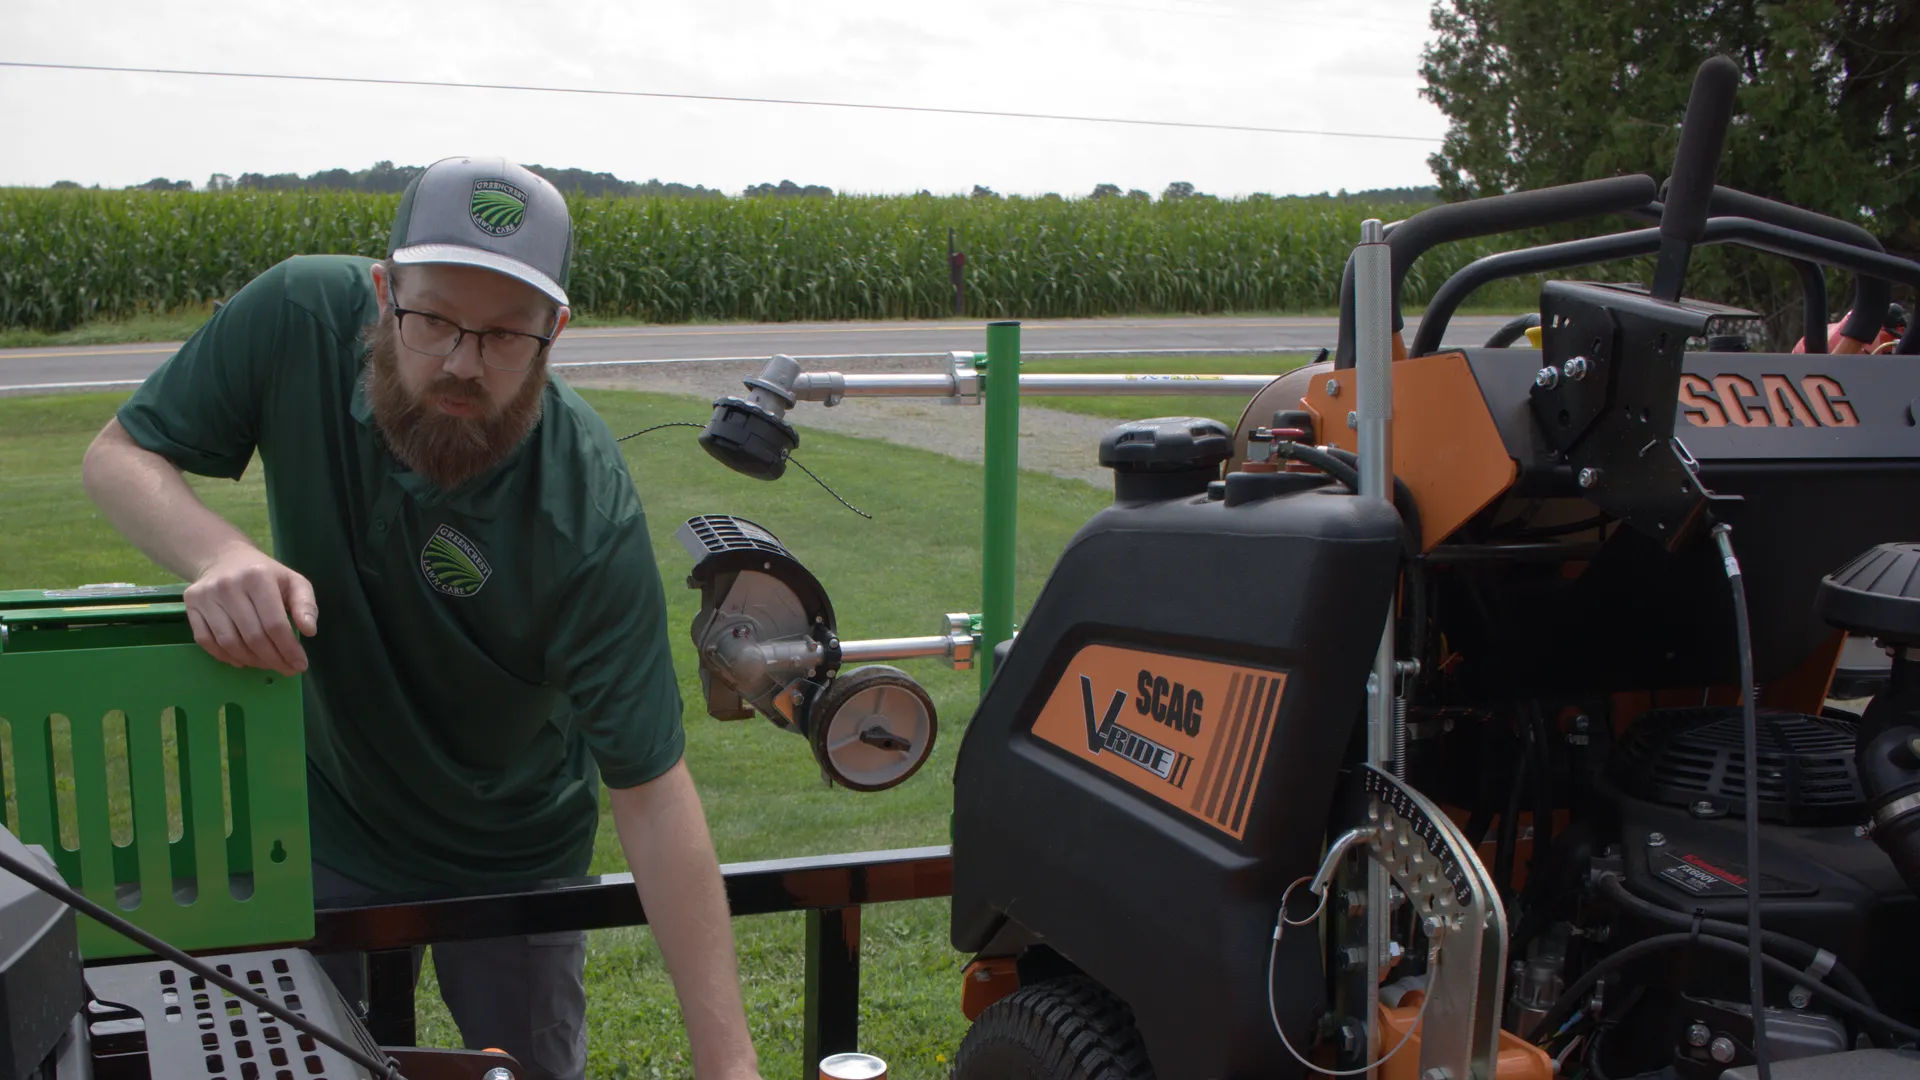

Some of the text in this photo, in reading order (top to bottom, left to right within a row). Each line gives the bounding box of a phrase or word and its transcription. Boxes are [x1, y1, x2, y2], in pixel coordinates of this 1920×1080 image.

[476, 181, 528, 201] GREENCREST
[473, 212, 516, 234] LAWN CARE
[1678, 373, 1860, 428] SCAG
[440, 527, 490, 575] GREENCREST
[423, 560, 466, 595] LAWN CARE
[1135, 669, 1204, 738] SCAG
[1677, 864, 1719, 884] FX600V
